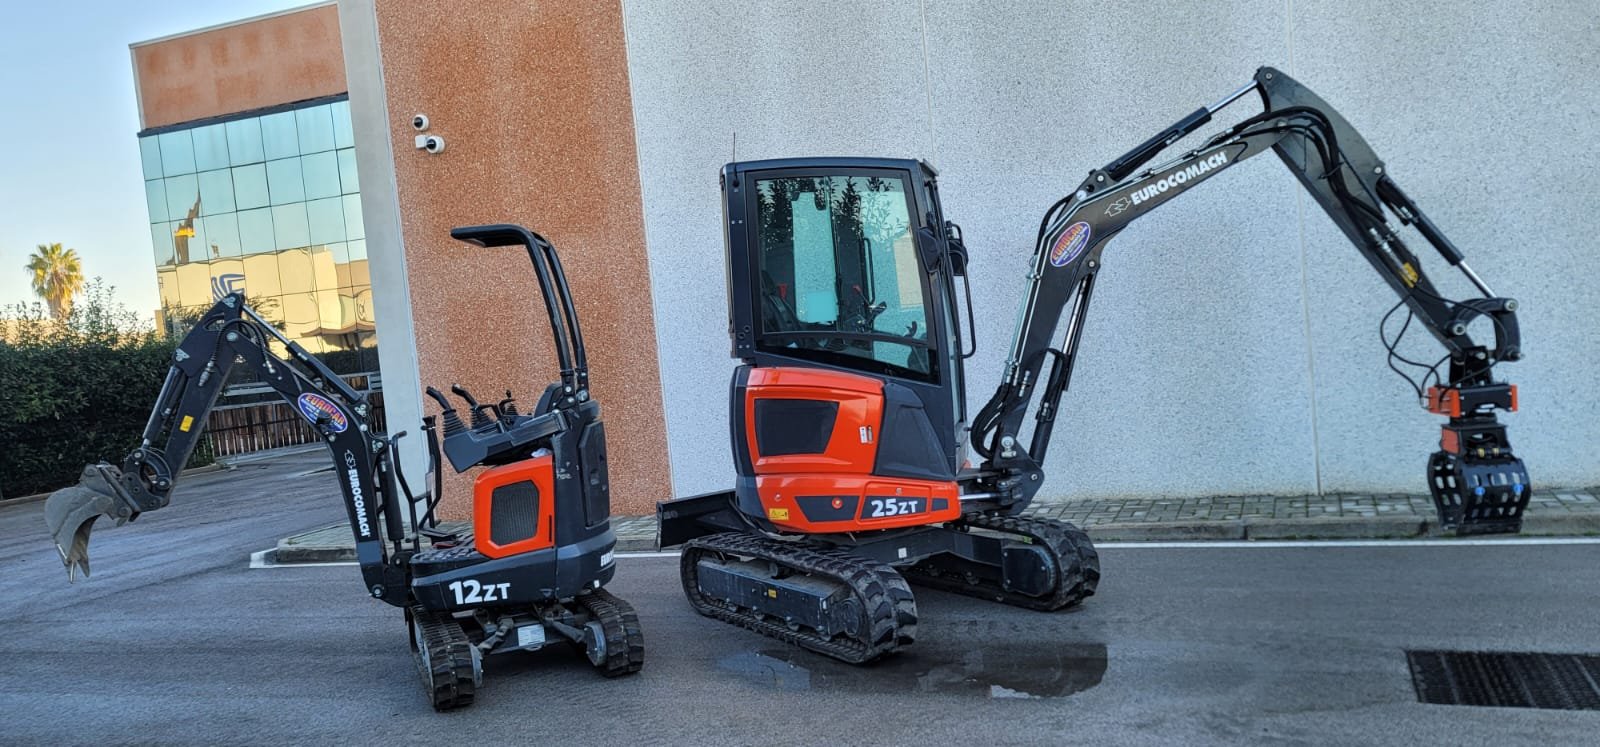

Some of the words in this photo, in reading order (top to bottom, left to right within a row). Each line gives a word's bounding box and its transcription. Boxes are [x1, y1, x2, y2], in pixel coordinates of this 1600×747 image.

[1130, 151, 1228, 205] EUROCOMACH
[348, 469, 371, 537] EUROCOMACH
[871, 498, 918, 518] 25ZT
[448, 579, 511, 605] 12ZT
